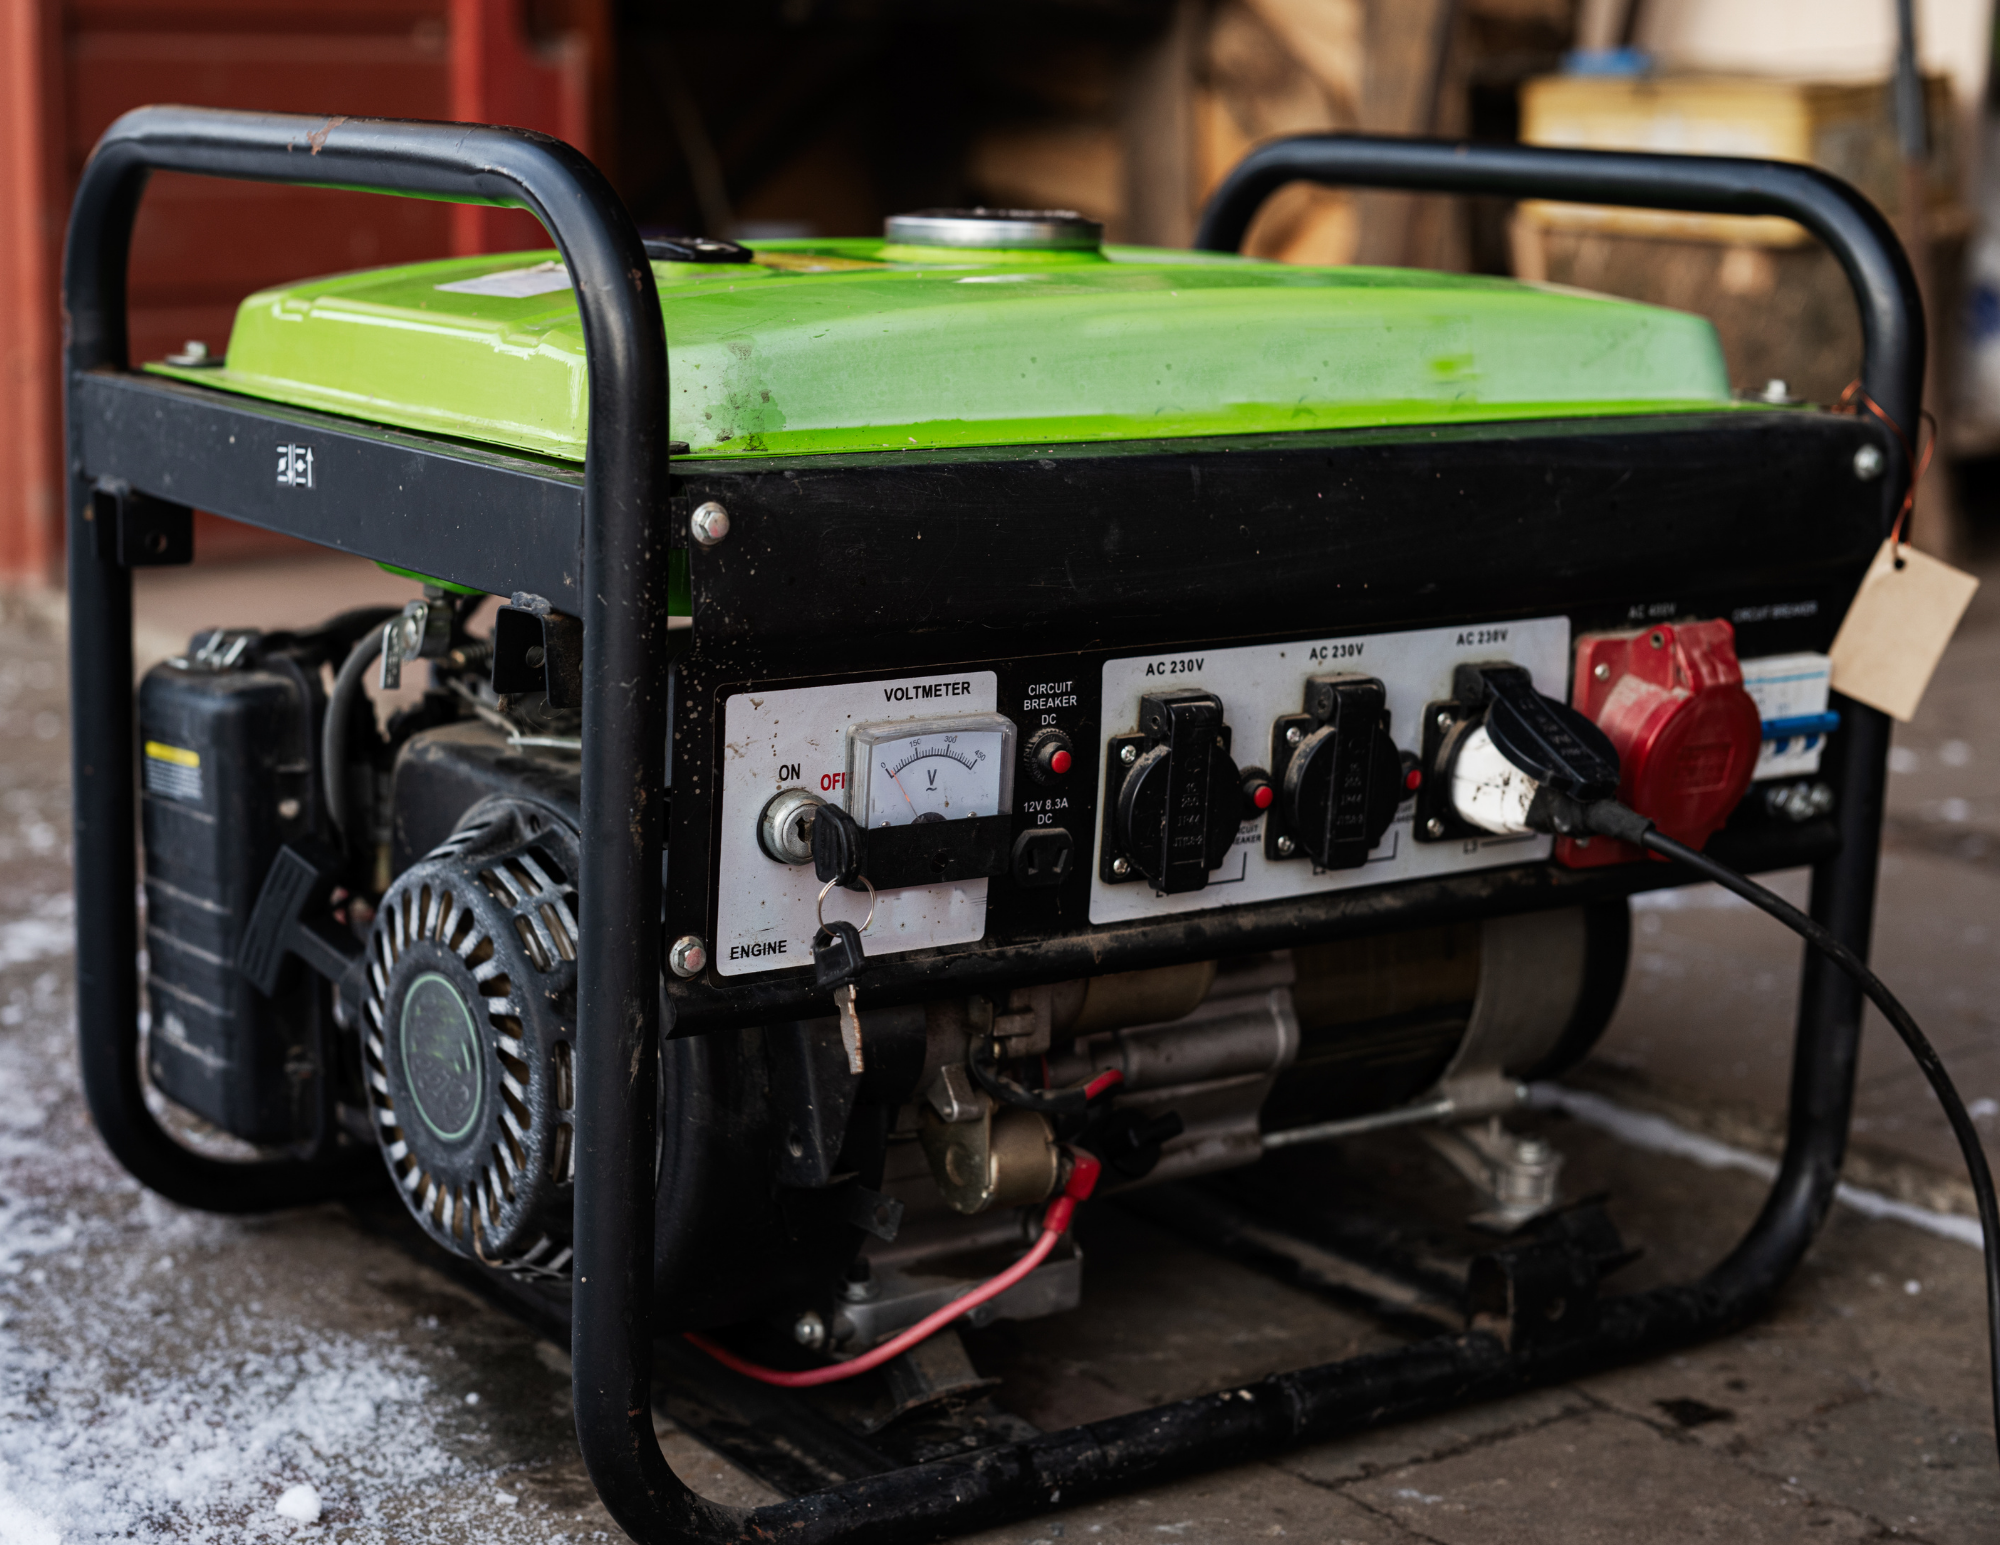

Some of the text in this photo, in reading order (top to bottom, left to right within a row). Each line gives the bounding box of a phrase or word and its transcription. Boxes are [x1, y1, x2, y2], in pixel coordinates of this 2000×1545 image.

[1456, 628, 1509, 646] AC 230V
[1309, 642, 1365, 661] AC 230V
[1145, 657, 1205, 677] AC 230V
[884, 681, 971, 702] VOLTMETER
[1028, 681, 1073, 696] CIRCUIT
[1023, 695, 1077, 711] BREAKER
[1041, 713, 1057, 726] DC
[909, 738, 922, 748] 150
[943, 735, 957, 744] 300
[974, 749, 986, 762] 450
[778, 763, 801, 782] ON
[880, 761, 887, 769] 0
[926, 768, 938, 786] V
[1023, 797, 1069, 813] 12V 8.3A
[1037, 812, 1053, 825] DC
[1233, 833, 1262, 845] EAKER
[729, 940, 787, 960] ENGINE
